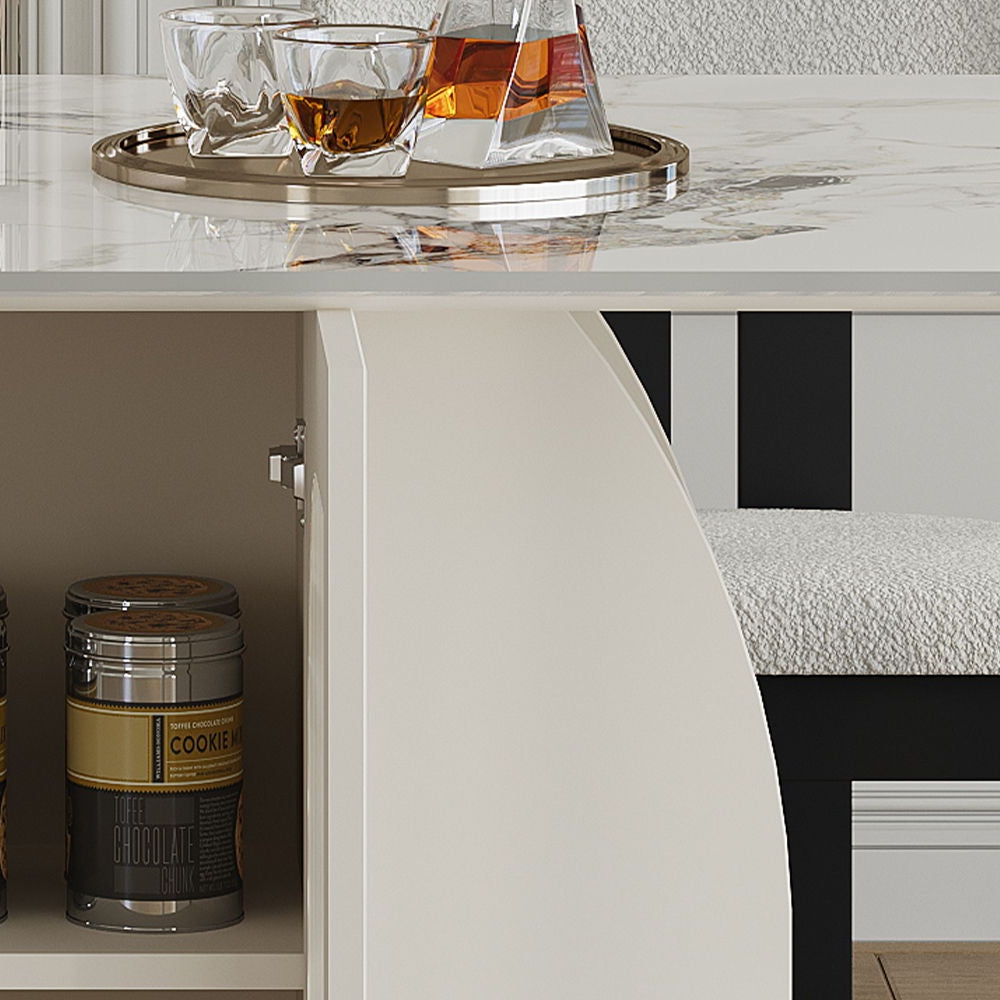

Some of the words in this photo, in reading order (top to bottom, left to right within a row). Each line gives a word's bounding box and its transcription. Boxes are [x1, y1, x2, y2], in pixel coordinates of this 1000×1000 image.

[192, 719, 220, 729] CHOCOLATE
[170, 730, 228, 755] COOKIE
[113, 825, 195, 865] CHOCOLATE
[161, 866, 195, 895] CHUNK
